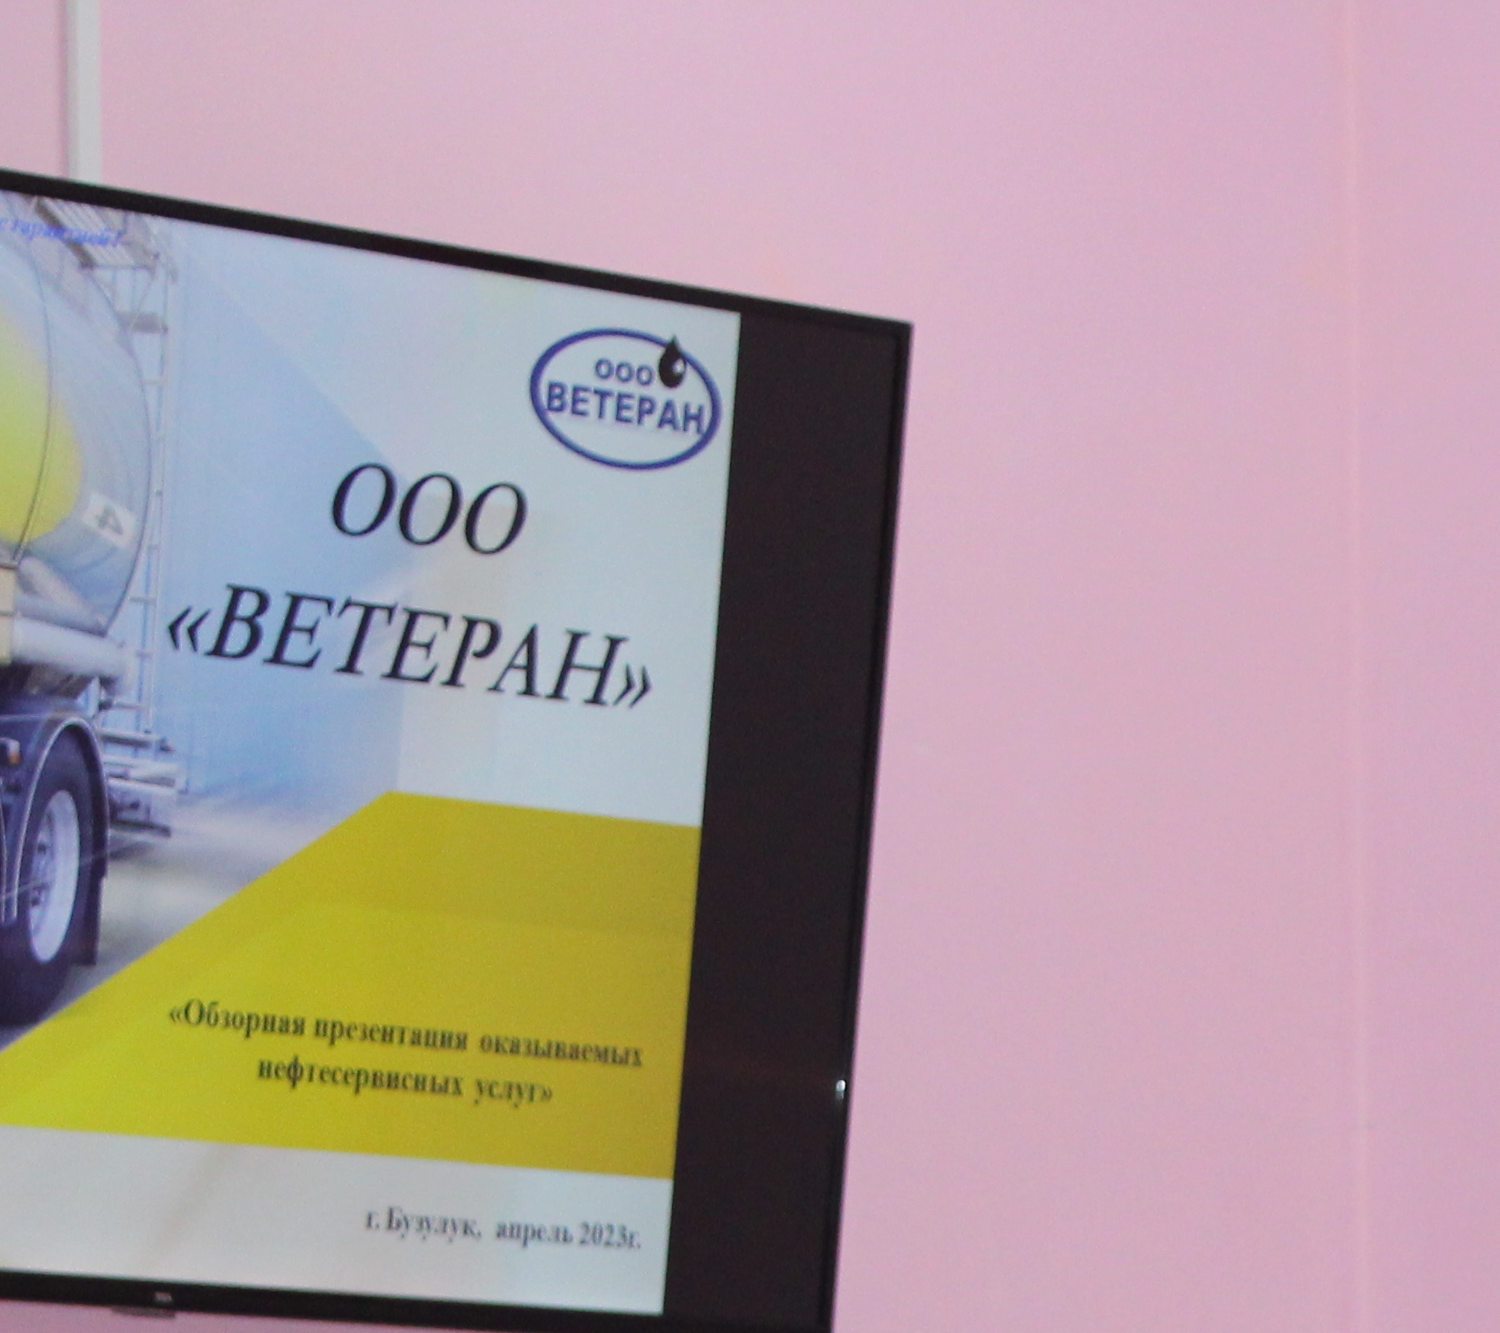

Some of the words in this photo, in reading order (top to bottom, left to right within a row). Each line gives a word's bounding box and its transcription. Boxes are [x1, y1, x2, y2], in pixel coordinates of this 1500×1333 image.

[594, 357, 654, 386] ООО
[546, 380, 705, 435] ВЕТЕРАН
[332, 462, 528, 555] ООО
[166, 583, 653, 708] «ВЕТЕРАН»
[168, 998, 306, 1039] «Обзорная
[313, 1014, 469, 1052] презентация
[479, 1033, 645, 1068] оказываемых
[257, 1055, 465, 1096] нефтесервисных
[474, 1078, 554, 1108] услуг»
[365, 1208, 381, 1231] г.
[385, 1205, 483, 1245] Бузулук,
[494, 1218, 575, 1249] апрель
